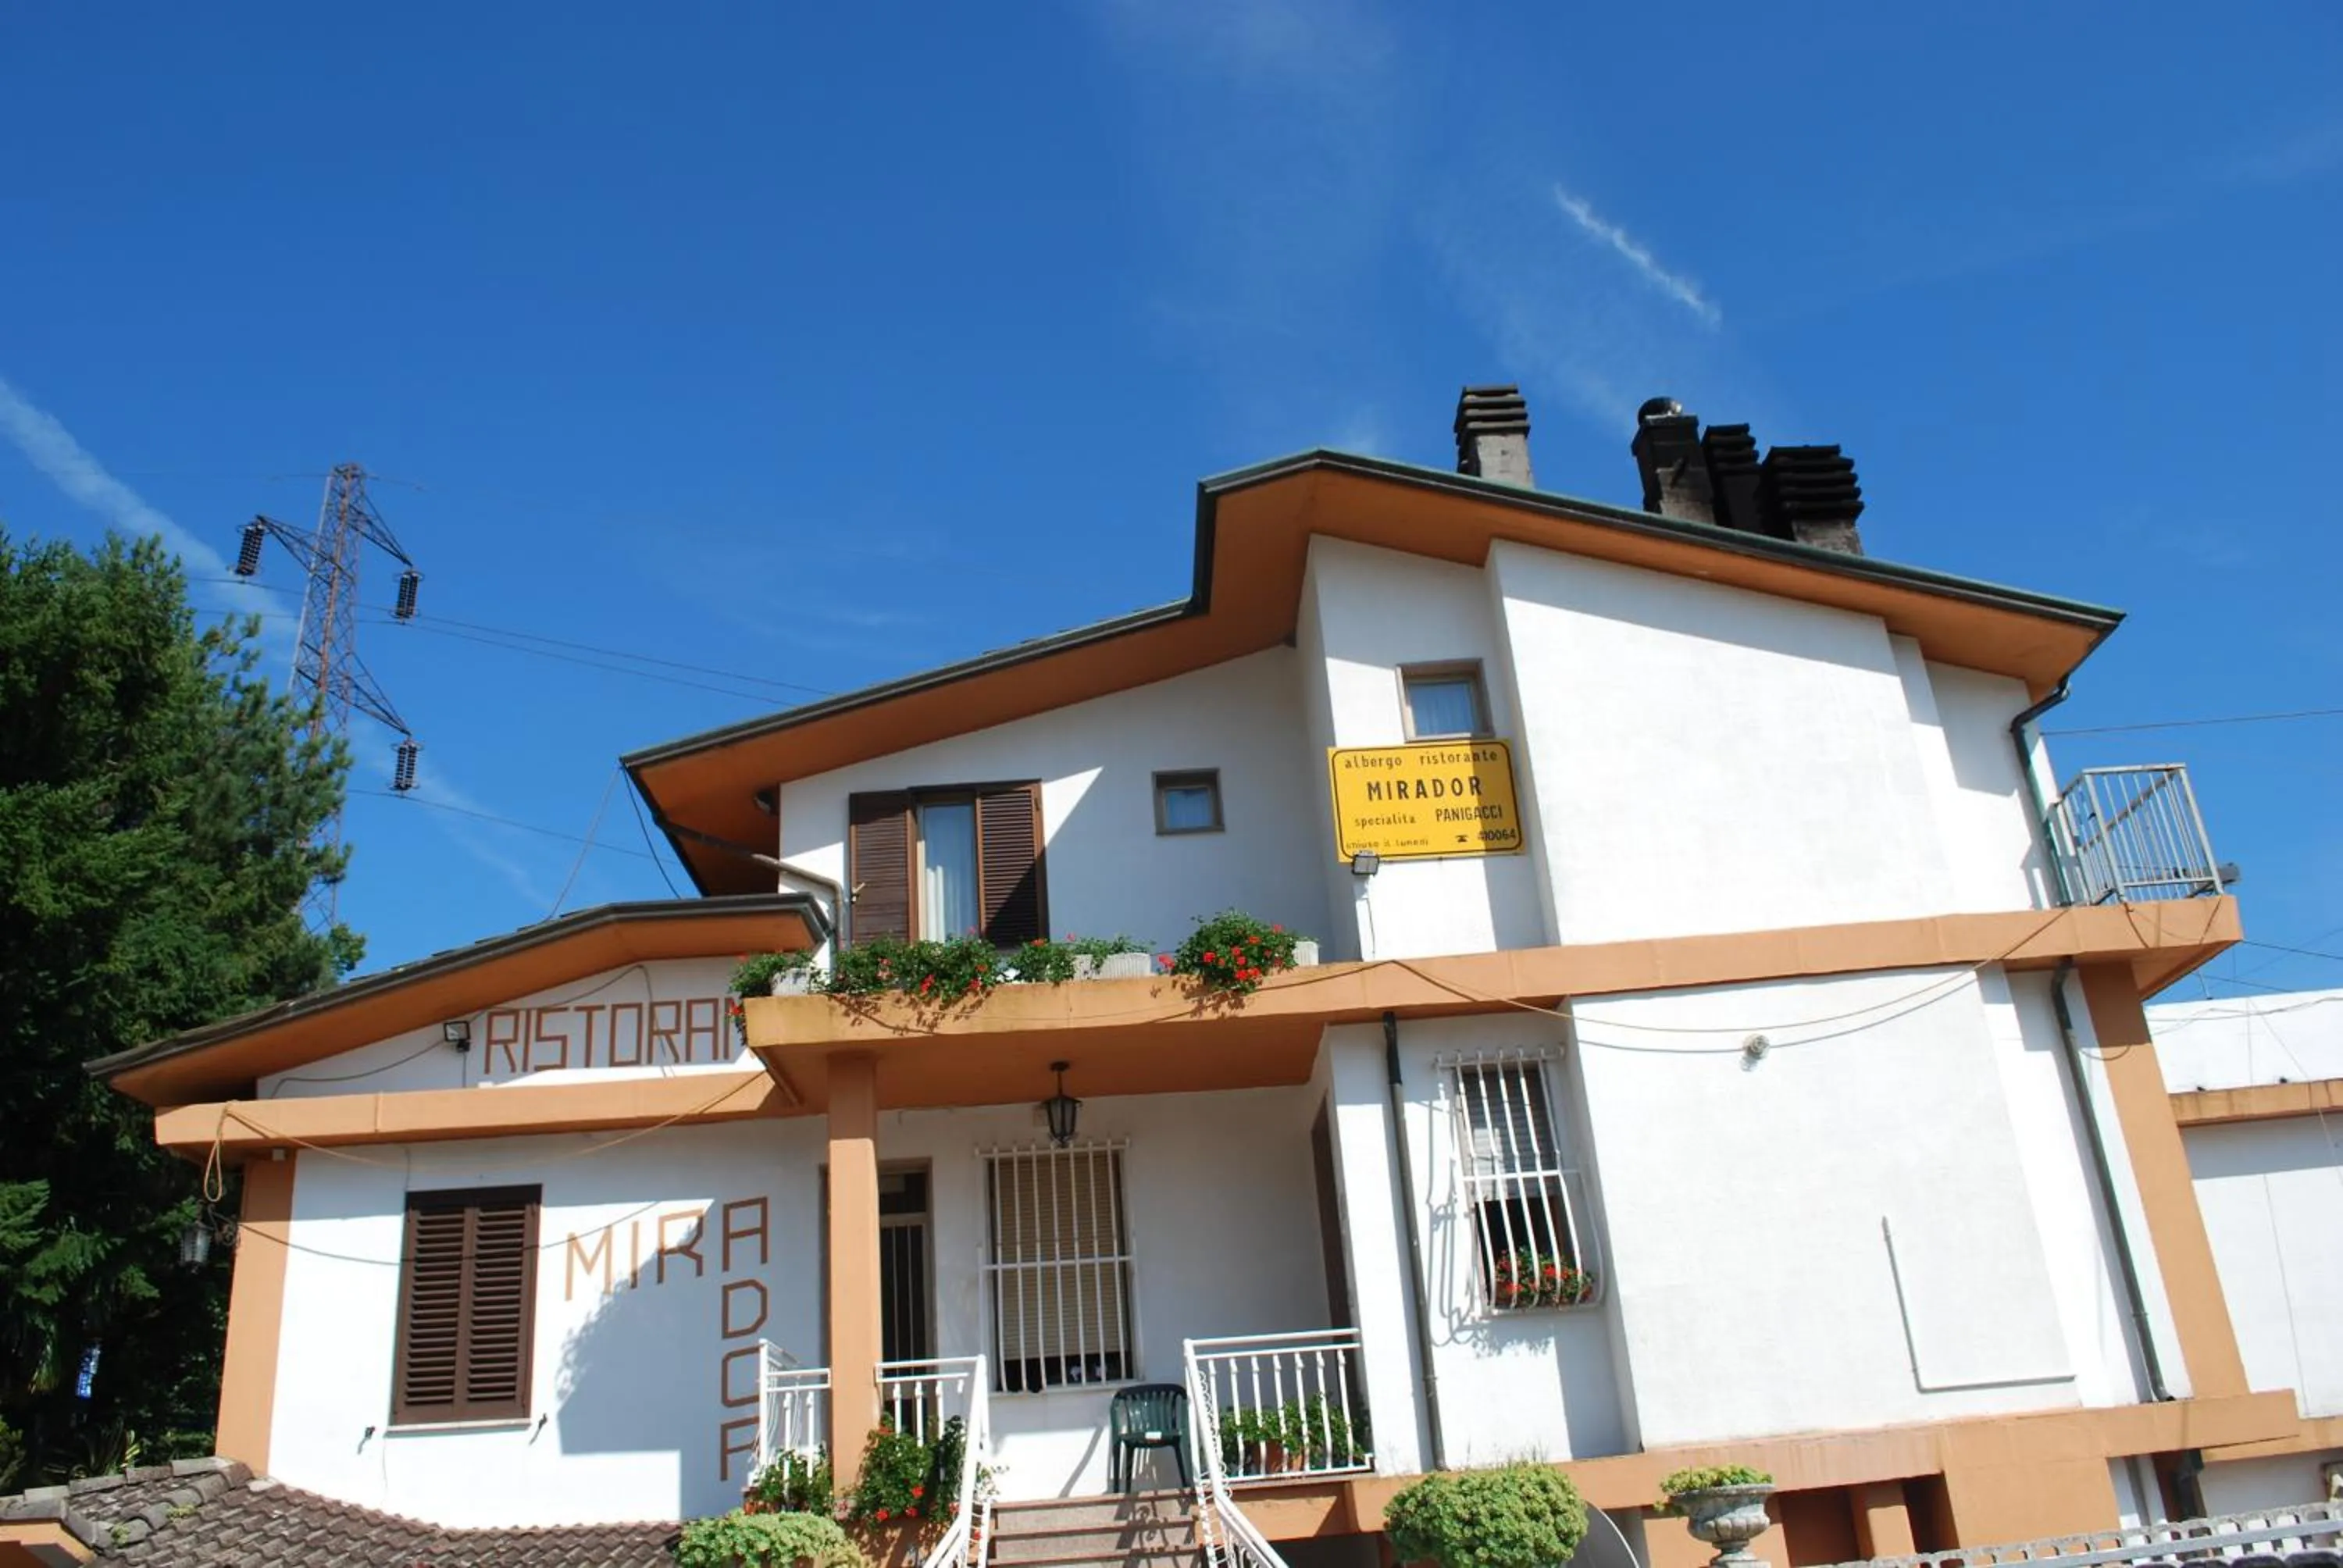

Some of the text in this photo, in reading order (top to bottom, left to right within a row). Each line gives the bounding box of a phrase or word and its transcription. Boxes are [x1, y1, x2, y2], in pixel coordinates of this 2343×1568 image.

[1344, 750, 1498, 770] albergo ristorante
[1367, 776, 1482, 801] MIRADOR
[1435, 805, 1503, 822] PANIGACCI
